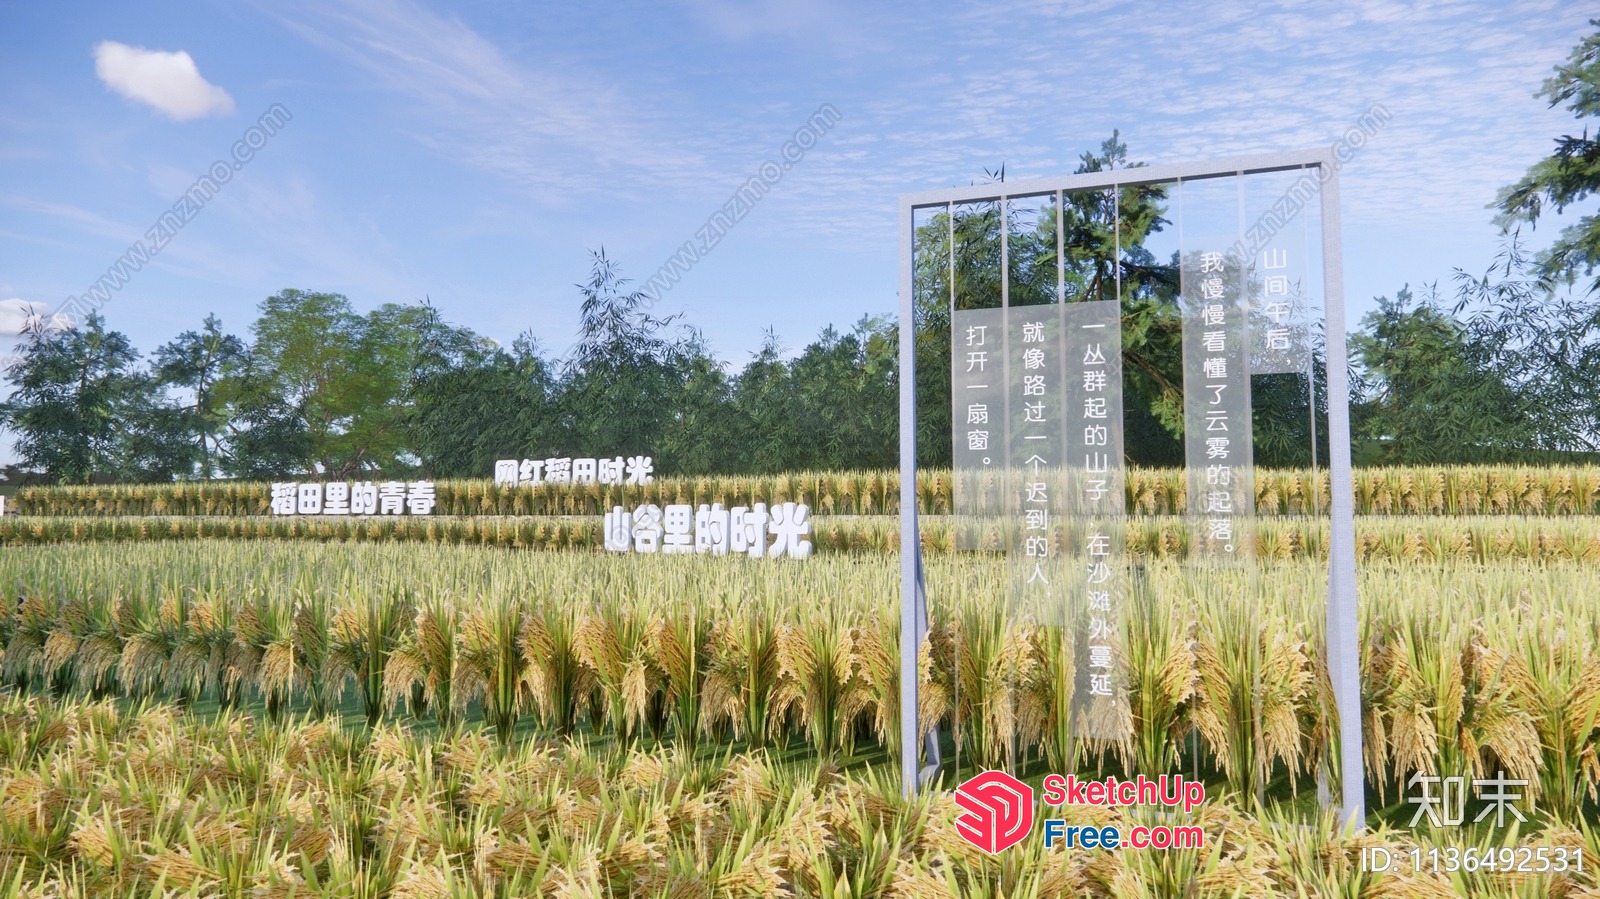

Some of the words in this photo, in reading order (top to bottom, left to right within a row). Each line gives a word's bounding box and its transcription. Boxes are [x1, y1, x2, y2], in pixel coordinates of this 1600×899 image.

[965, 325, 991, 468] 打开一扇窗。
[1199, 251, 1234, 554] 我慢慢看懂了云雾的起落。
[270, 480, 437, 516] 稻田里的青春
[494, 455, 655, 487] 网红稻田时光
[604, 501, 813, 560] 山谷里的时光
